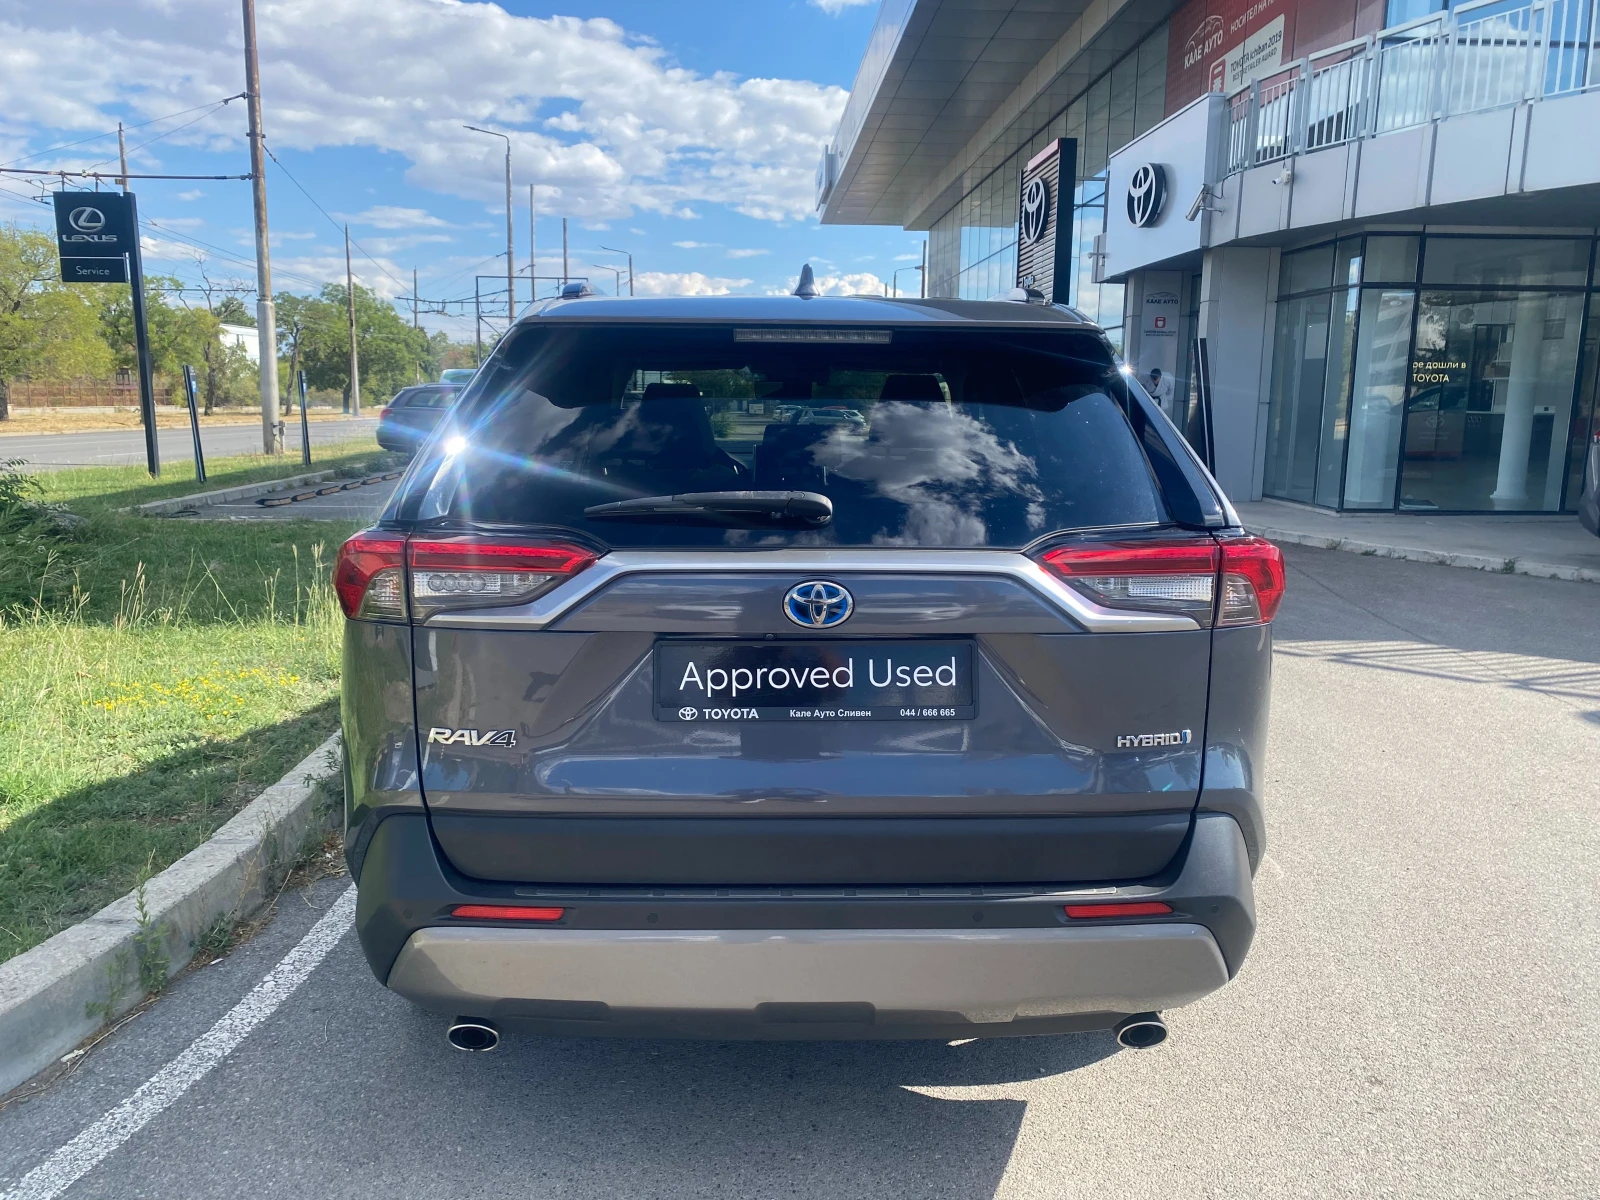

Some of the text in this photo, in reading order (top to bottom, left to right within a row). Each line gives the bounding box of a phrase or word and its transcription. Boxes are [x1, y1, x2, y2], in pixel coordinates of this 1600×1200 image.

[1267, 30, 1283, 48] 2019
[1184, 29, 1224, 69] КАЛЕ АУТО
[62, 234, 118, 242] LEXUS
[75, 265, 111, 275] Service
[1425, 361, 1459, 370] дошли
[1412, 374, 1450, 382] TOYOTA
[679, 656, 957, 698] Approved Used
[702, 708, 760, 720] TOYOTA
[789, 708, 872, 719] Кале Ауто Сливен
[900, 708, 916, 717] 044
[922, 708, 938, 717] 666
[939, 708, 956, 717] 665
[427, 727, 517, 749] RAV4
[1116, 732, 1182, 748] HYBRID
